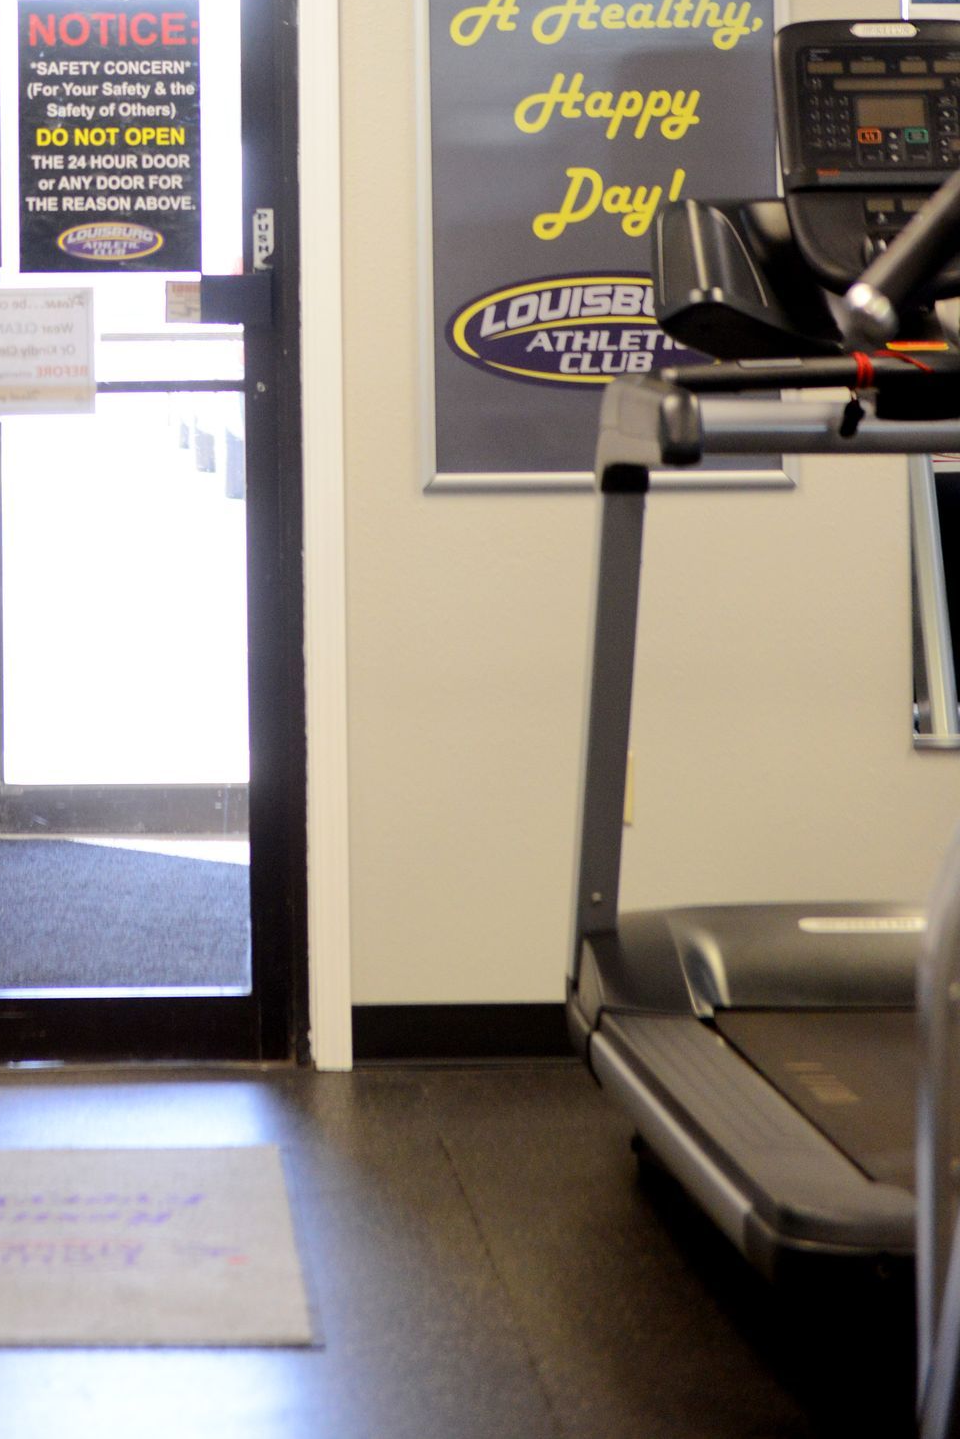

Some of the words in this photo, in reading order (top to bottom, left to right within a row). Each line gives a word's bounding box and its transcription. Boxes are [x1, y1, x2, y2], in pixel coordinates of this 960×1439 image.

[28, 12, 199, 46] NOTICE:
[27, 83, 59, 99] (For
[63, 83, 98, 96] Your
[102, 82, 150, 98] Safety
[155, 82, 166, 95] &
[170, 82, 196, 95] the
[47, 103, 95, 120] Safety
[99, 103, 115, 116] of
[119, 103, 176, 119] Others)
[513, 72, 700, 140] Happy
[36, 128, 68, 146] DO
[75, 128, 119, 146] NOT
[125, 128, 184, 145] OPEN
[32, 155, 63, 169] THE
[68, 155, 86, 169] 24
[90, 155, 137, 169] HOUR
[142, 154, 190, 168] DOOR
[39, 179, 55, 190] or
[58, 176, 92, 190] ANY
[96, 176, 144, 190] DOOR
[149, 175, 182, 189] FOR
[26, 197, 58, 211] THE
[63, 197, 130, 210] REASON
[135, 196, 195, 210] ABOVE.
[532, 167, 686, 240] Day!
[480, 285, 656, 338] LOUISB
[559, 352, 654, 374] CLUB
